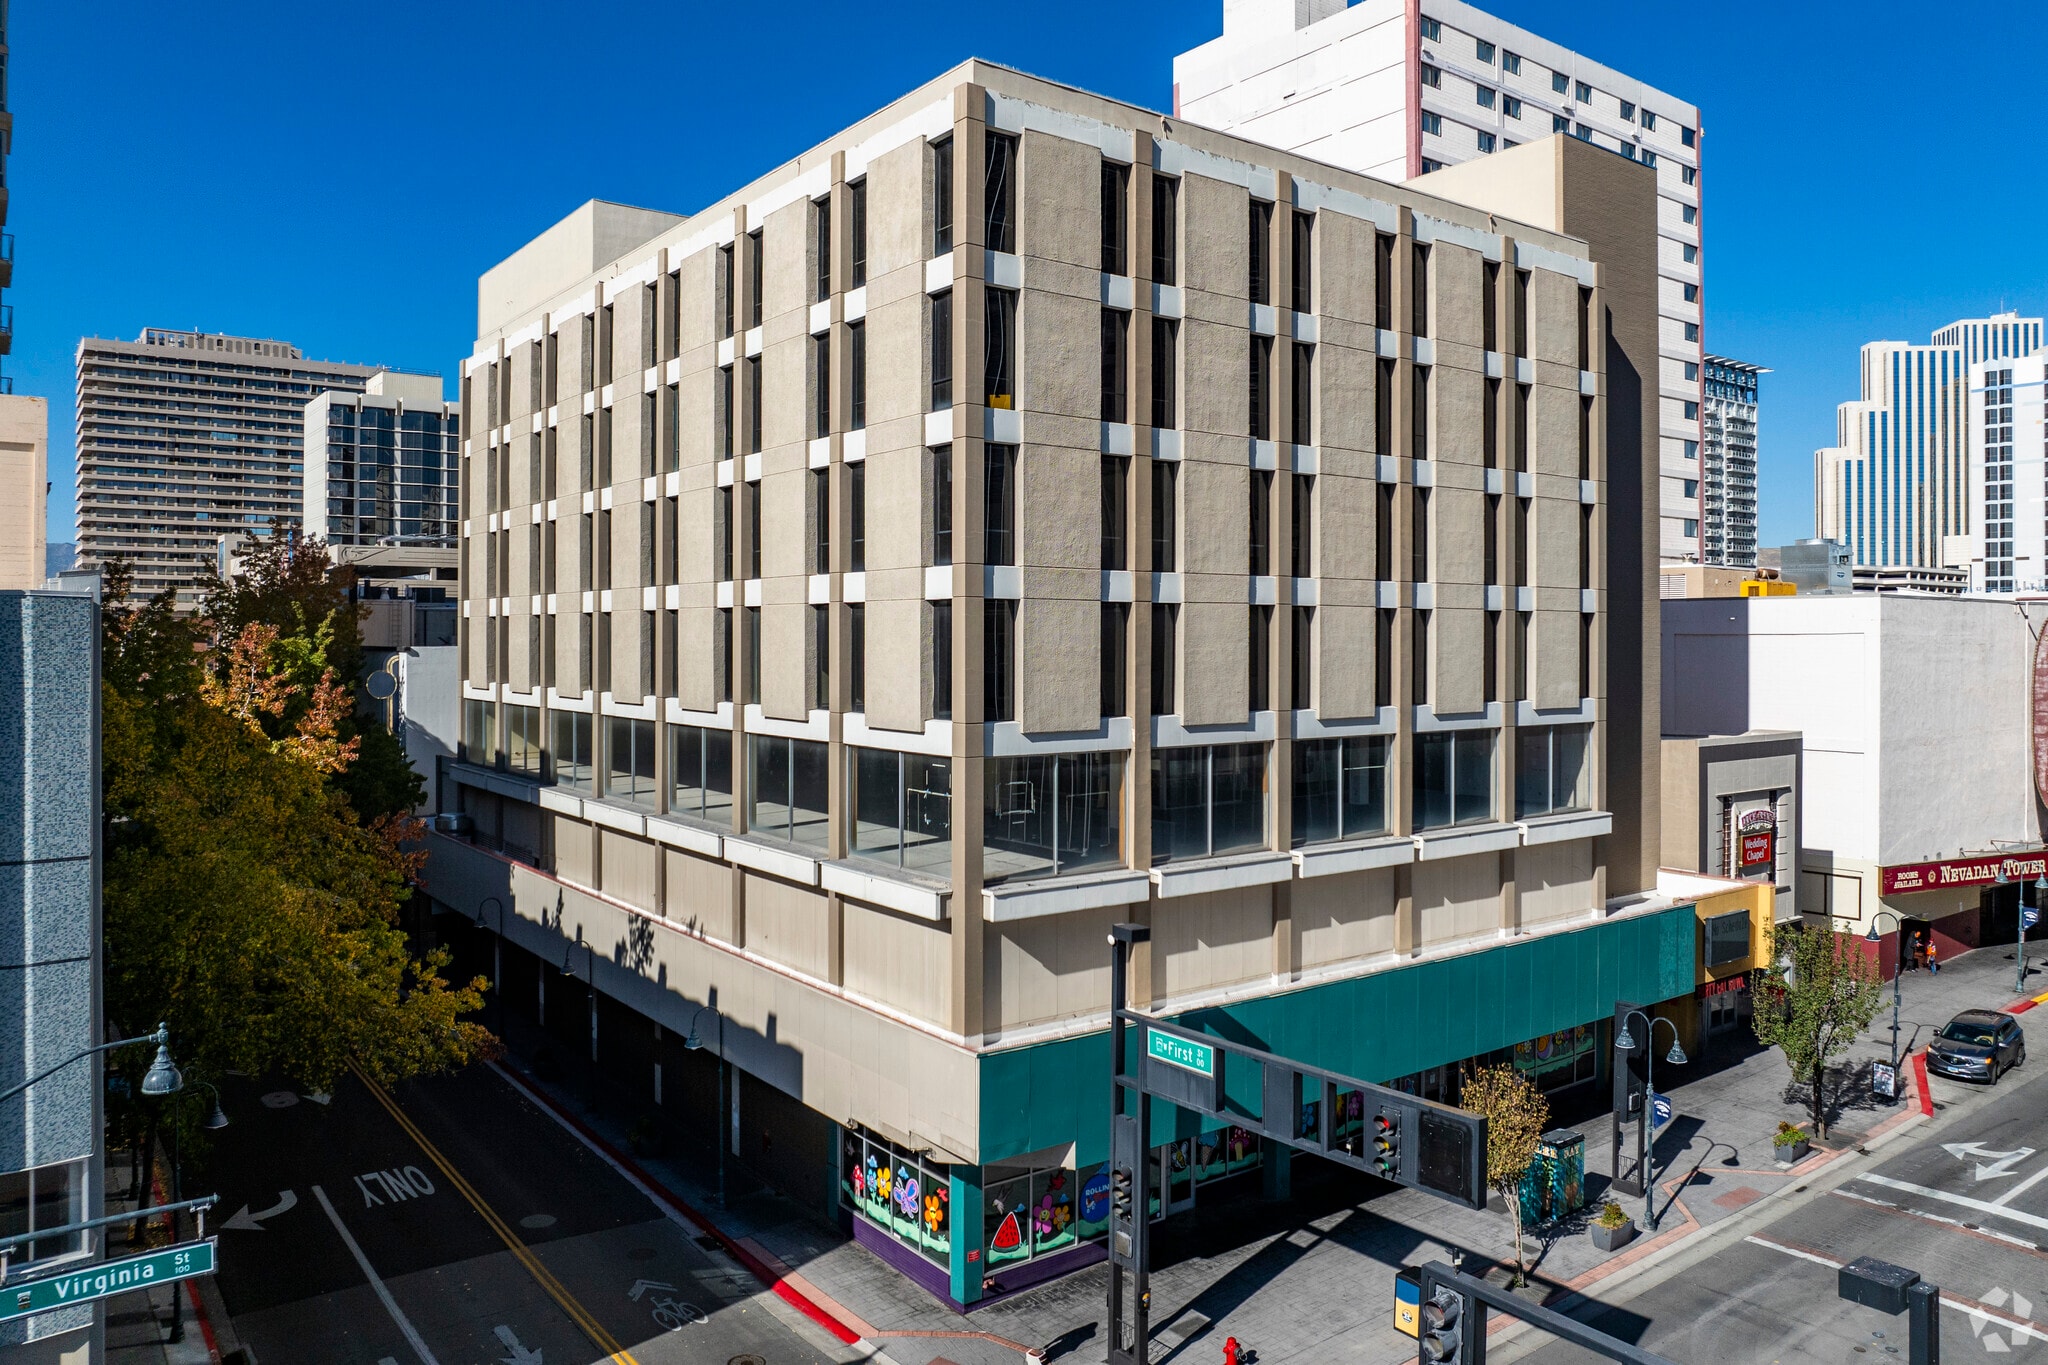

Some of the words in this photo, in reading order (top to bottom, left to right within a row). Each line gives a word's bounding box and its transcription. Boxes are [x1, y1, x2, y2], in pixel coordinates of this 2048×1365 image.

[1745, 838, 1767, 849] Wedding
[1747, 849, 1764, 861] Chapel
[1897, 871, 1919, 880] ROOMS
[1940, 864, 1999, 883] NEVADAN
[1894, 879, 1923, 889] AVAILABLE
[1168, 1041, 1193, 1063] First
[1197, 1048, 1203, 1058] St
[353, 1165, 436, 1208] ONLY
[1086, 1184, 1110, 1196] ROLLIN
[54, 1263, 155, 1299] Virginia
[174, 1251, 190, 1265] St
[174, 1264, 190, 1274] 100
